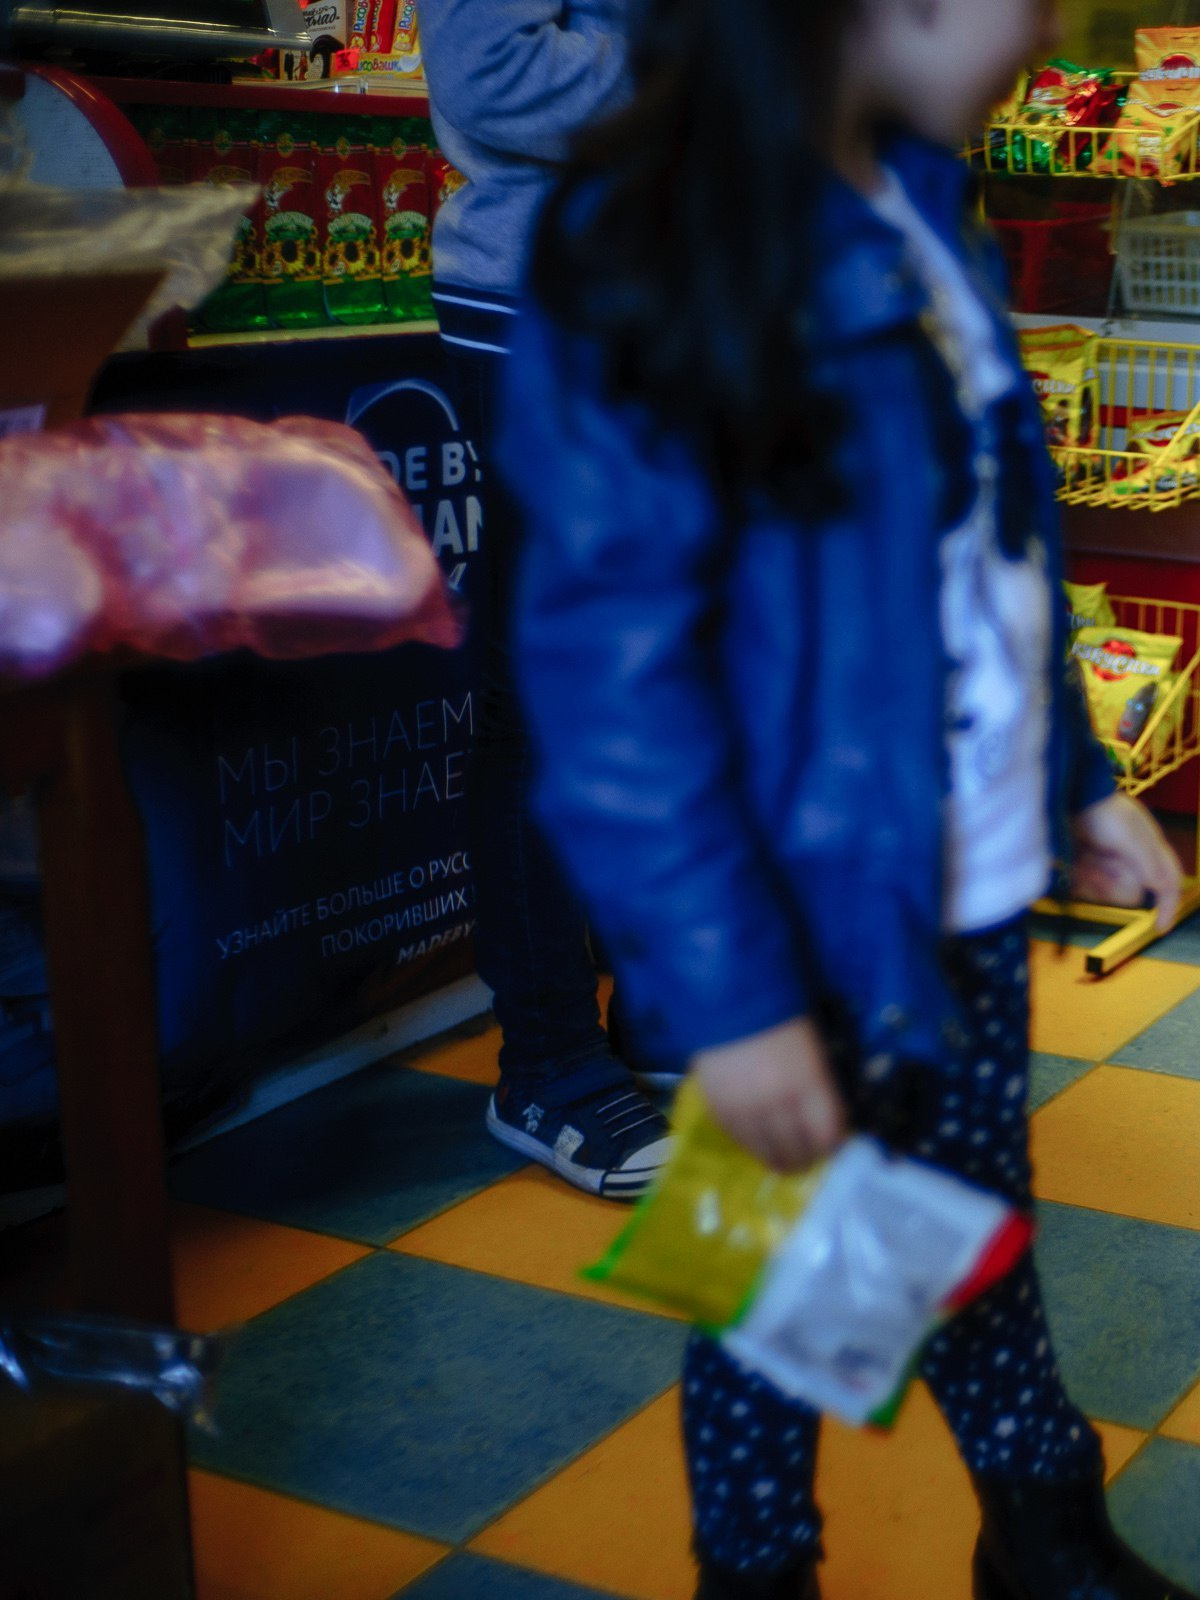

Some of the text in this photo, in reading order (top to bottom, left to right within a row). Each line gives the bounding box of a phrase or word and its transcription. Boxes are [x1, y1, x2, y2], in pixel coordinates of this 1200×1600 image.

[217, 690, 475, 805] МЫ ЗНАЕМ
[224, 749, 472, 868] МИР ЗНАЕ
[215, 903, 311, 960] УЗНАЙТЕ
[316, 871, 406, 921] БОЛЬШЕ
[408, 865, 427, 890] О
[320, 886, 468, 958] ПОКОРИВШИХ
